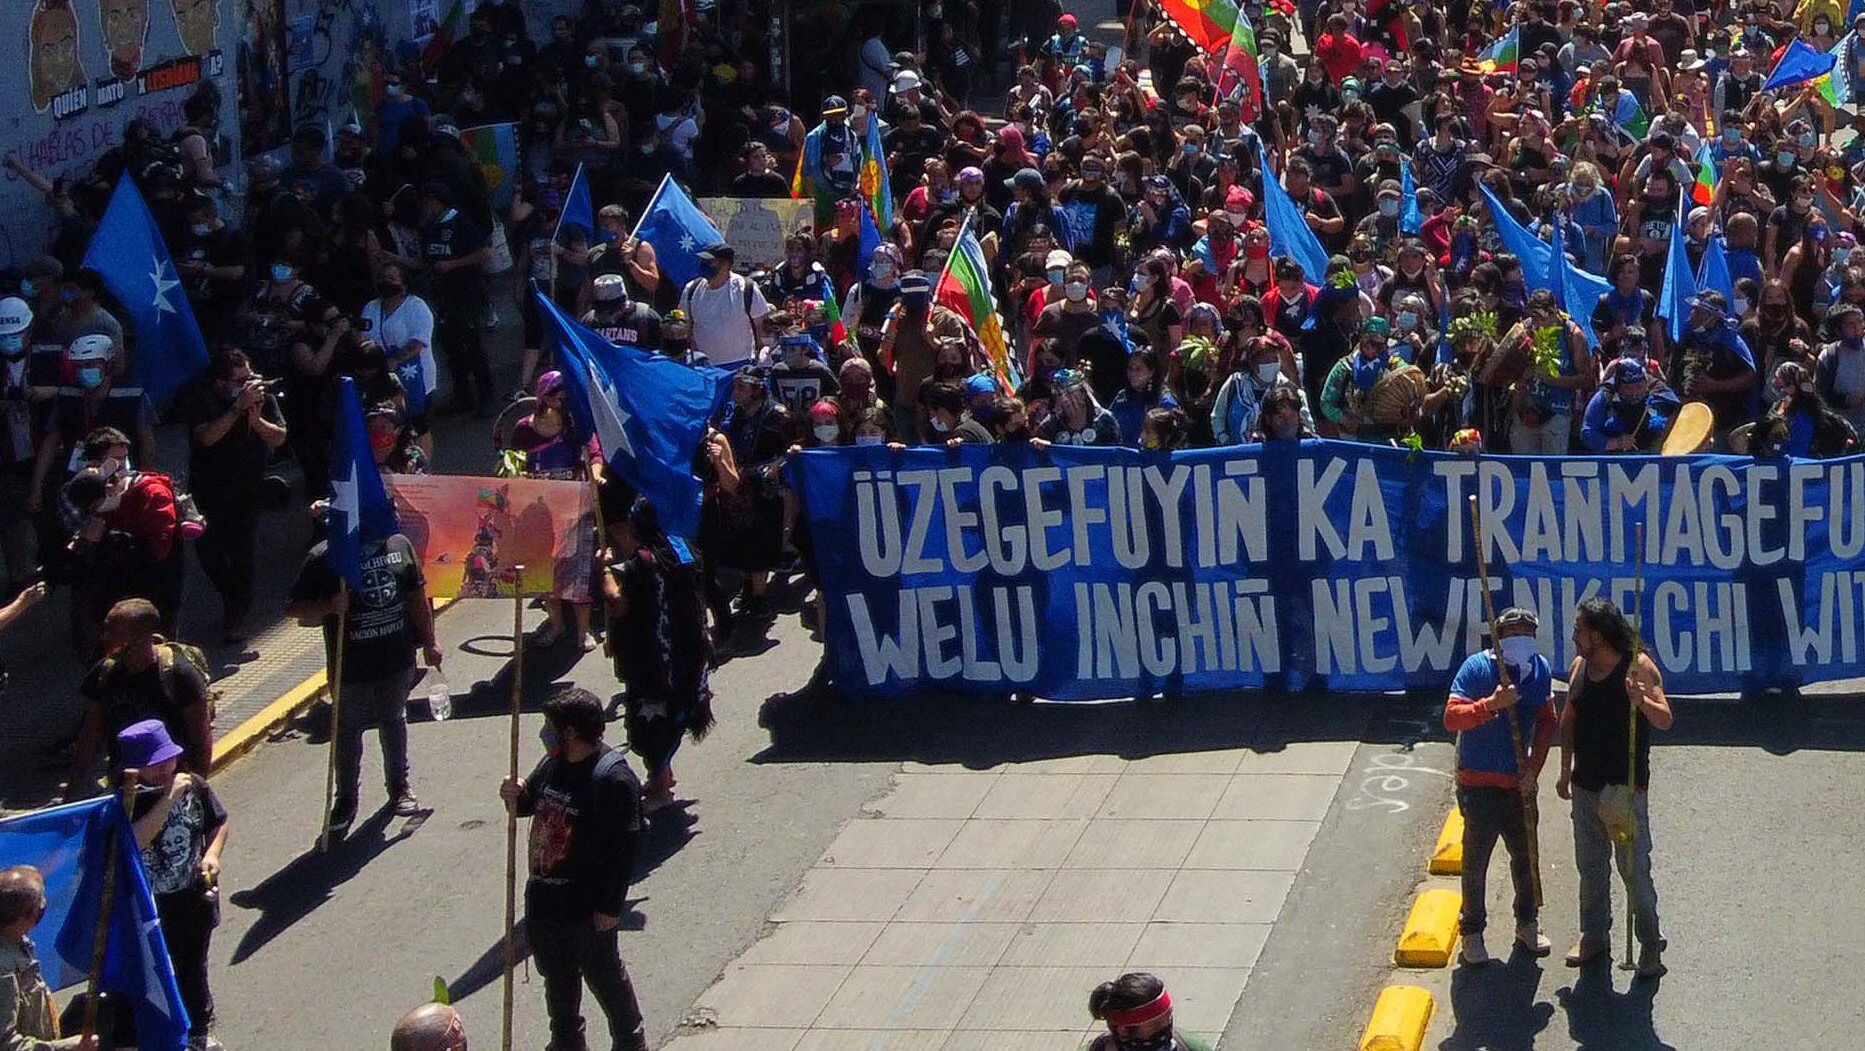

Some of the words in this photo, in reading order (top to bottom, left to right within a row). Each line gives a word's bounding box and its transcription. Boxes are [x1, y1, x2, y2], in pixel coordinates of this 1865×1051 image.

[54, 86, 86, 119] QUIÉN
[0, 316, 20, 325] ENSA
[594, 327, 638, 343] ARTANS
[1297, 457, 1397, 562] KA
[846, 584, 1038, 685] WELU
[1077, 577, 1280, 681] INCHIÑ
